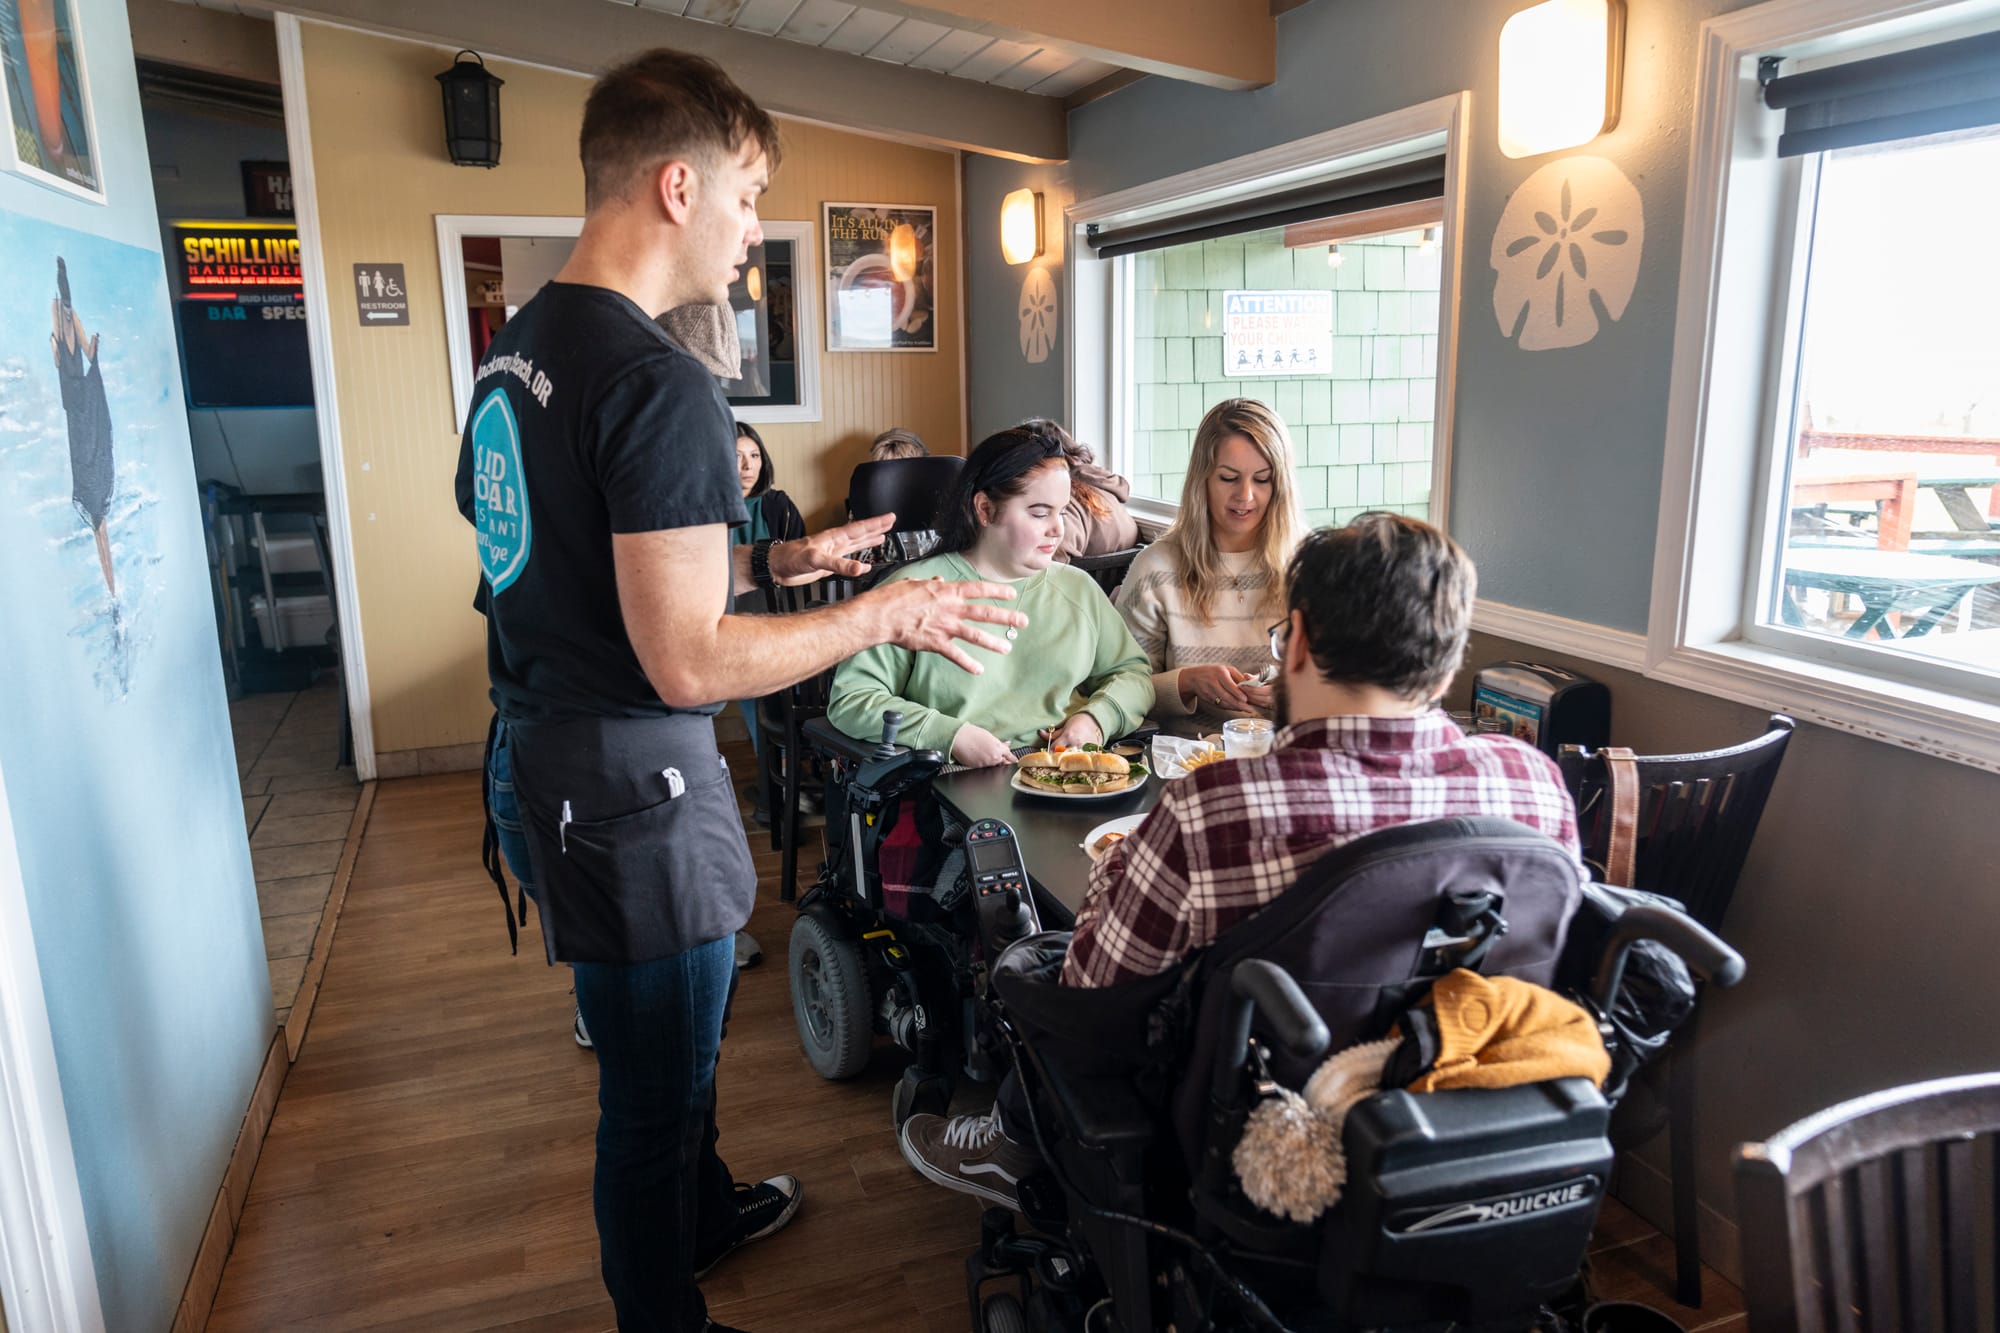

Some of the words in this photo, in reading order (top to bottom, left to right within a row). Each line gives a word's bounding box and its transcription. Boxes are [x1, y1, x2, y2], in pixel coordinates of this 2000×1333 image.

[858, 217, 880, 229] ALL
[884, 218, 899, 230] IN
[831, 228, 858, 240] THE
[184, 237, 300, 264] SCHILLING
[238, 294, 261, 303] BUD
[262, 294, 293, 303] LIGHT
[1229, 295, 1327, 313] ATTENTION
[208, 306, 247, 320] BAR
[262, 306, 305, 320] SPEC
[360, 302, 406, 310] RESTROOM
[1232, 315, 1279, 329] PLEASE
[1231, 331, 1264, 346] YOUR
[531, 369, 553, 409] OR
[1491, 1183, 1585, 1219] QUICKIE
